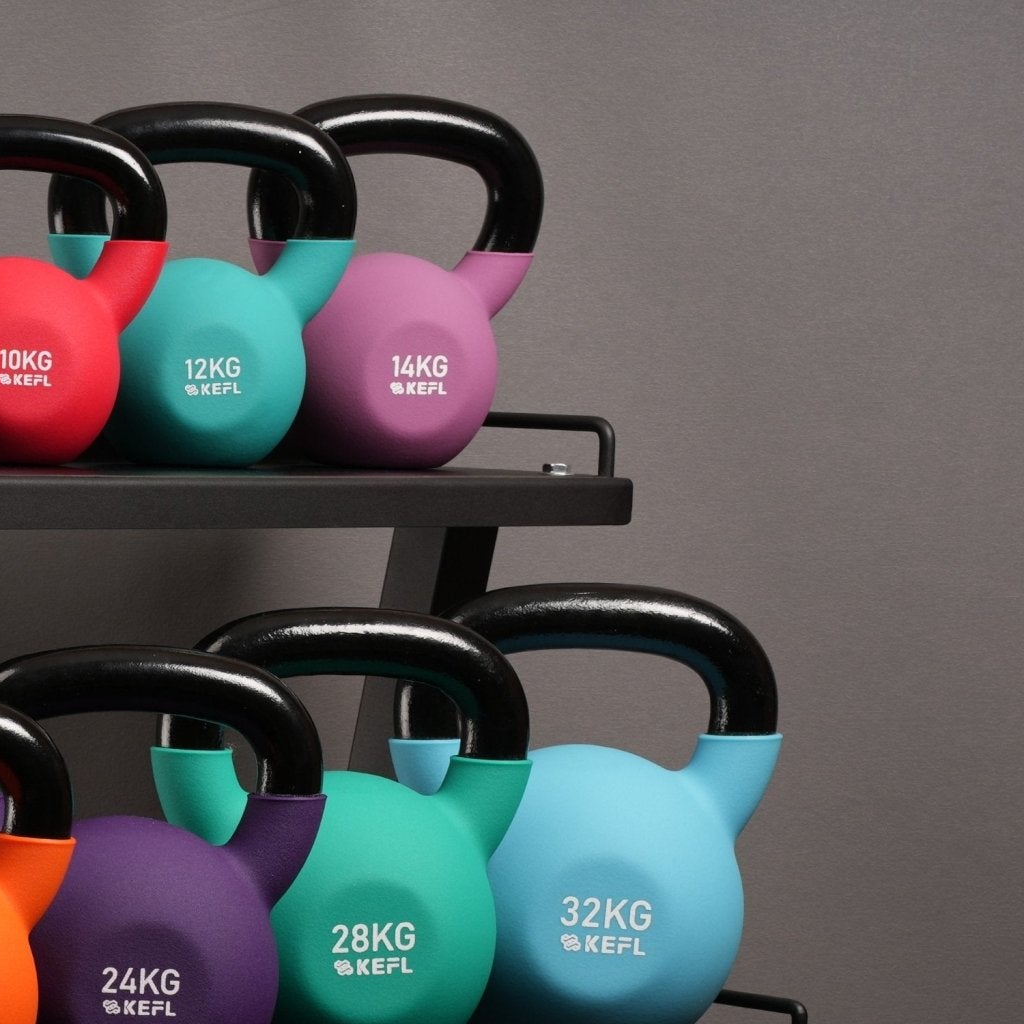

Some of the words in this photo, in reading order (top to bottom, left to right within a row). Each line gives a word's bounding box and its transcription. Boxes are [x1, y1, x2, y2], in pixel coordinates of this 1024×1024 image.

[0, 348, 53, 372] 10KG
[184, 357, 241, 380] 12KG
[391, 354, 448, 378] 14KG
[13, 373, 52, 387] KEFL
[200, 381, 242, 396] KEFL
[405, 381, 447, 395] KEFL
[560, 895, 652, 932] 32KG
[331, 921, 416, 954] 28KG
[584, 934, 646, 956] KEFL
[356, 956, 414, 976] KEFL
[101, 966, 181, 996] 24KG
[123, 999, 177, 1017] KEFL
